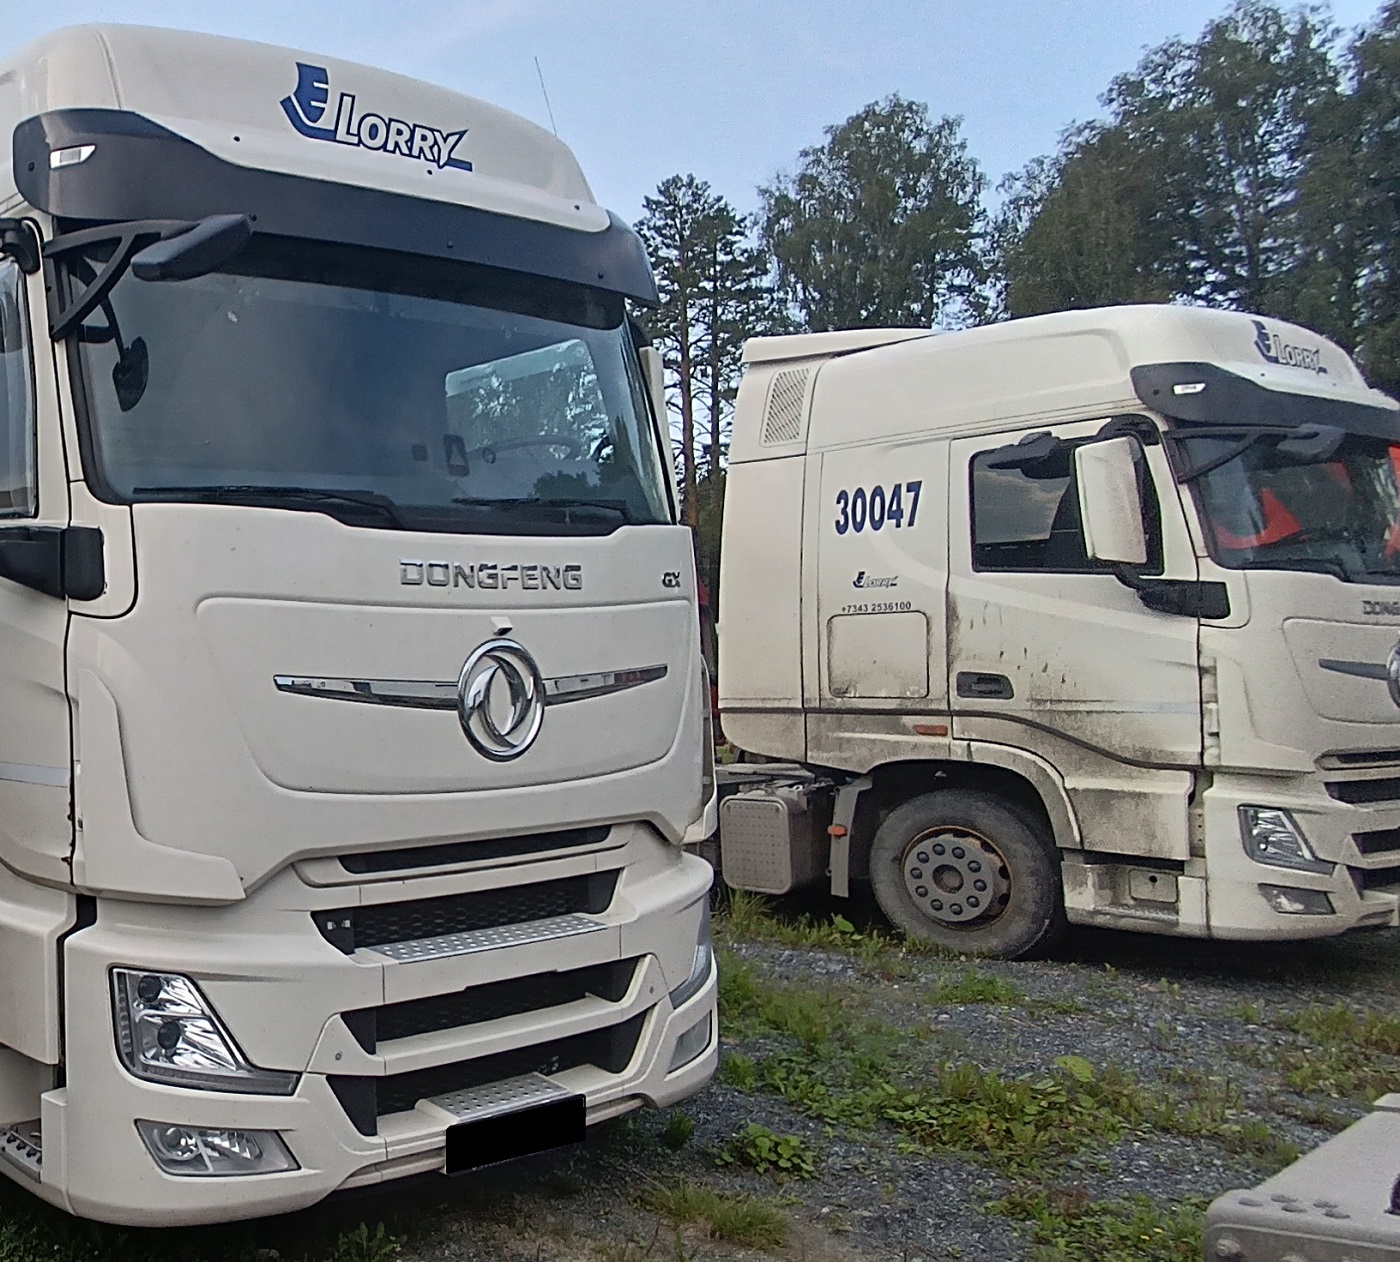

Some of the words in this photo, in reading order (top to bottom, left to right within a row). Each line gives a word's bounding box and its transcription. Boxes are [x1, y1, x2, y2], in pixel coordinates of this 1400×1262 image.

[835, 480, 923, 535] 30047
[400, 559, 583, 590] DONGFENG
[662, 571, 681, 588] GX
[841, 604, 869, 613] +7343
[871, 601, 912, 612] 2536100
